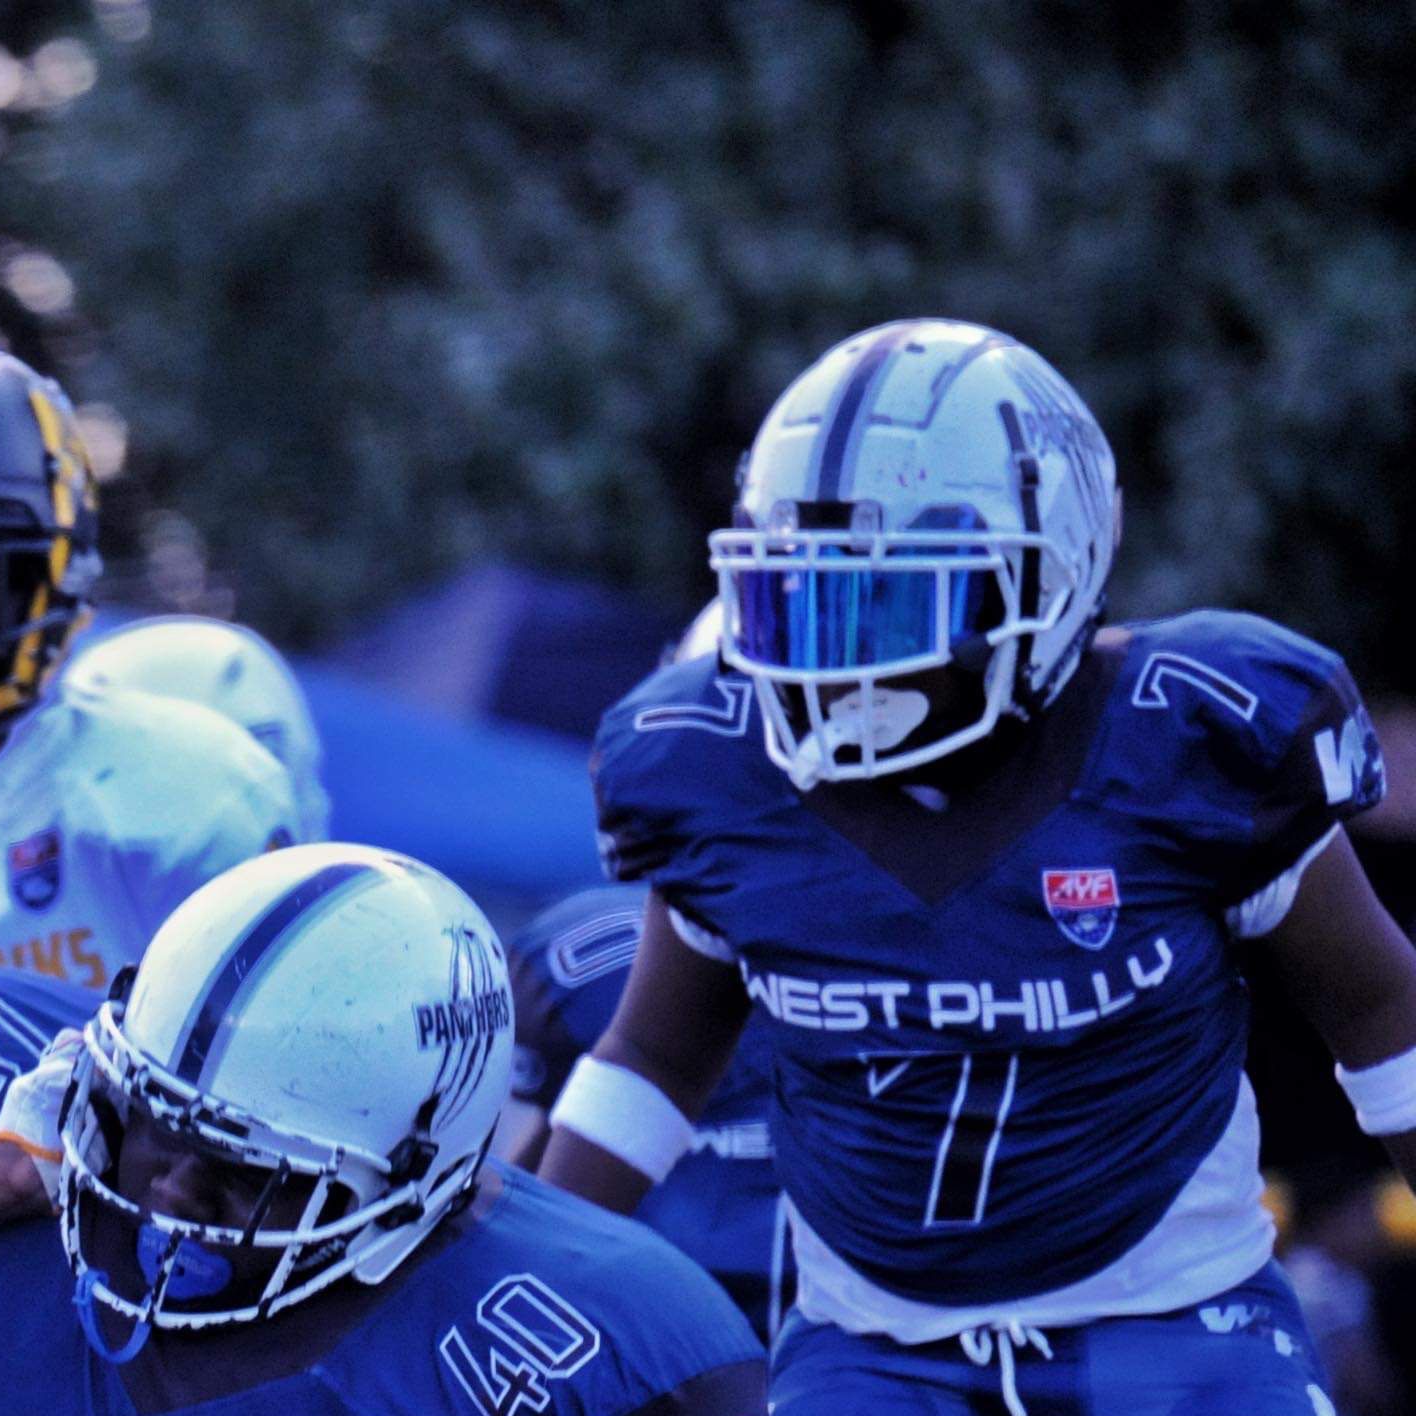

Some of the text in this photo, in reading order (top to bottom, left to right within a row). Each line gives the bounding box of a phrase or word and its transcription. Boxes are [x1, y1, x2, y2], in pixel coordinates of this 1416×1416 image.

[1132, 653, 1258, 722] 7
[738, 937, 1173, 1032] WEST PHILLY
